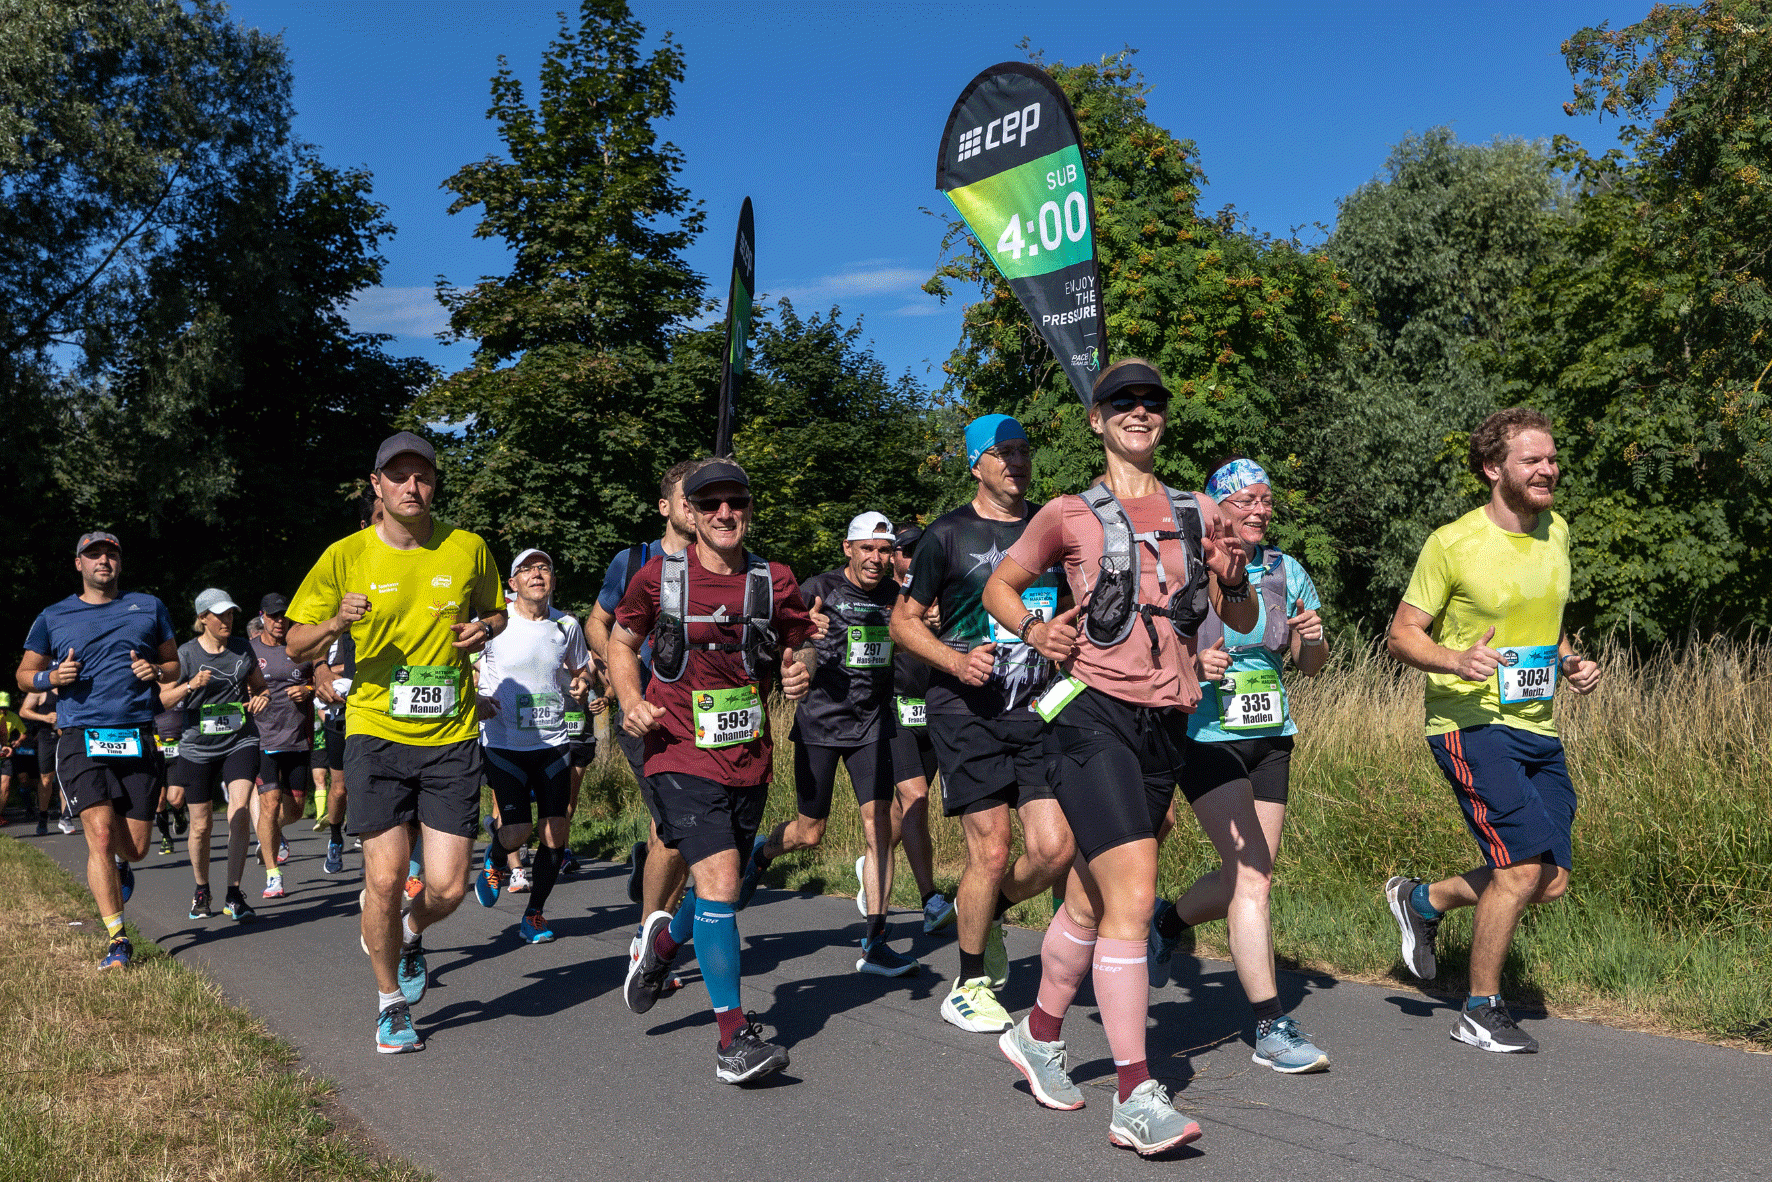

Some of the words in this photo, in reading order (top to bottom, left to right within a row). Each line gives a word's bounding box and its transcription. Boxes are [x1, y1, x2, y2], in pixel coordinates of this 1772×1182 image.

[985, 102, 1041, 150] cep
[1046, 164, 1077, 190] SUB
[996, 191, 1087, 259] 4:00
[1065, 275, 1095, 295] ENJOY
[1076, 289, 1096, 306] THE
[1042, 304, 1097, 327] PRESSURE
[864, 642, 881, 656] 297
[856, 656, 886, 664] Hans-Peter
[1517, 667, 1550, 687] 3034
[411, 686, 442, 703] 258
[1521, 687, 1545, 698] Moritz
[410, 704, 442, 713] Manuel
[1240, 693, 1271, 713] 335
[531, 706, 551, 719] 326
[717, 710, 749, 731] 593
[1242, 713, 1273, 724] Madlen
[713, 729, 753, 743] Johannes
[99, 741, 127, 750] 2037
